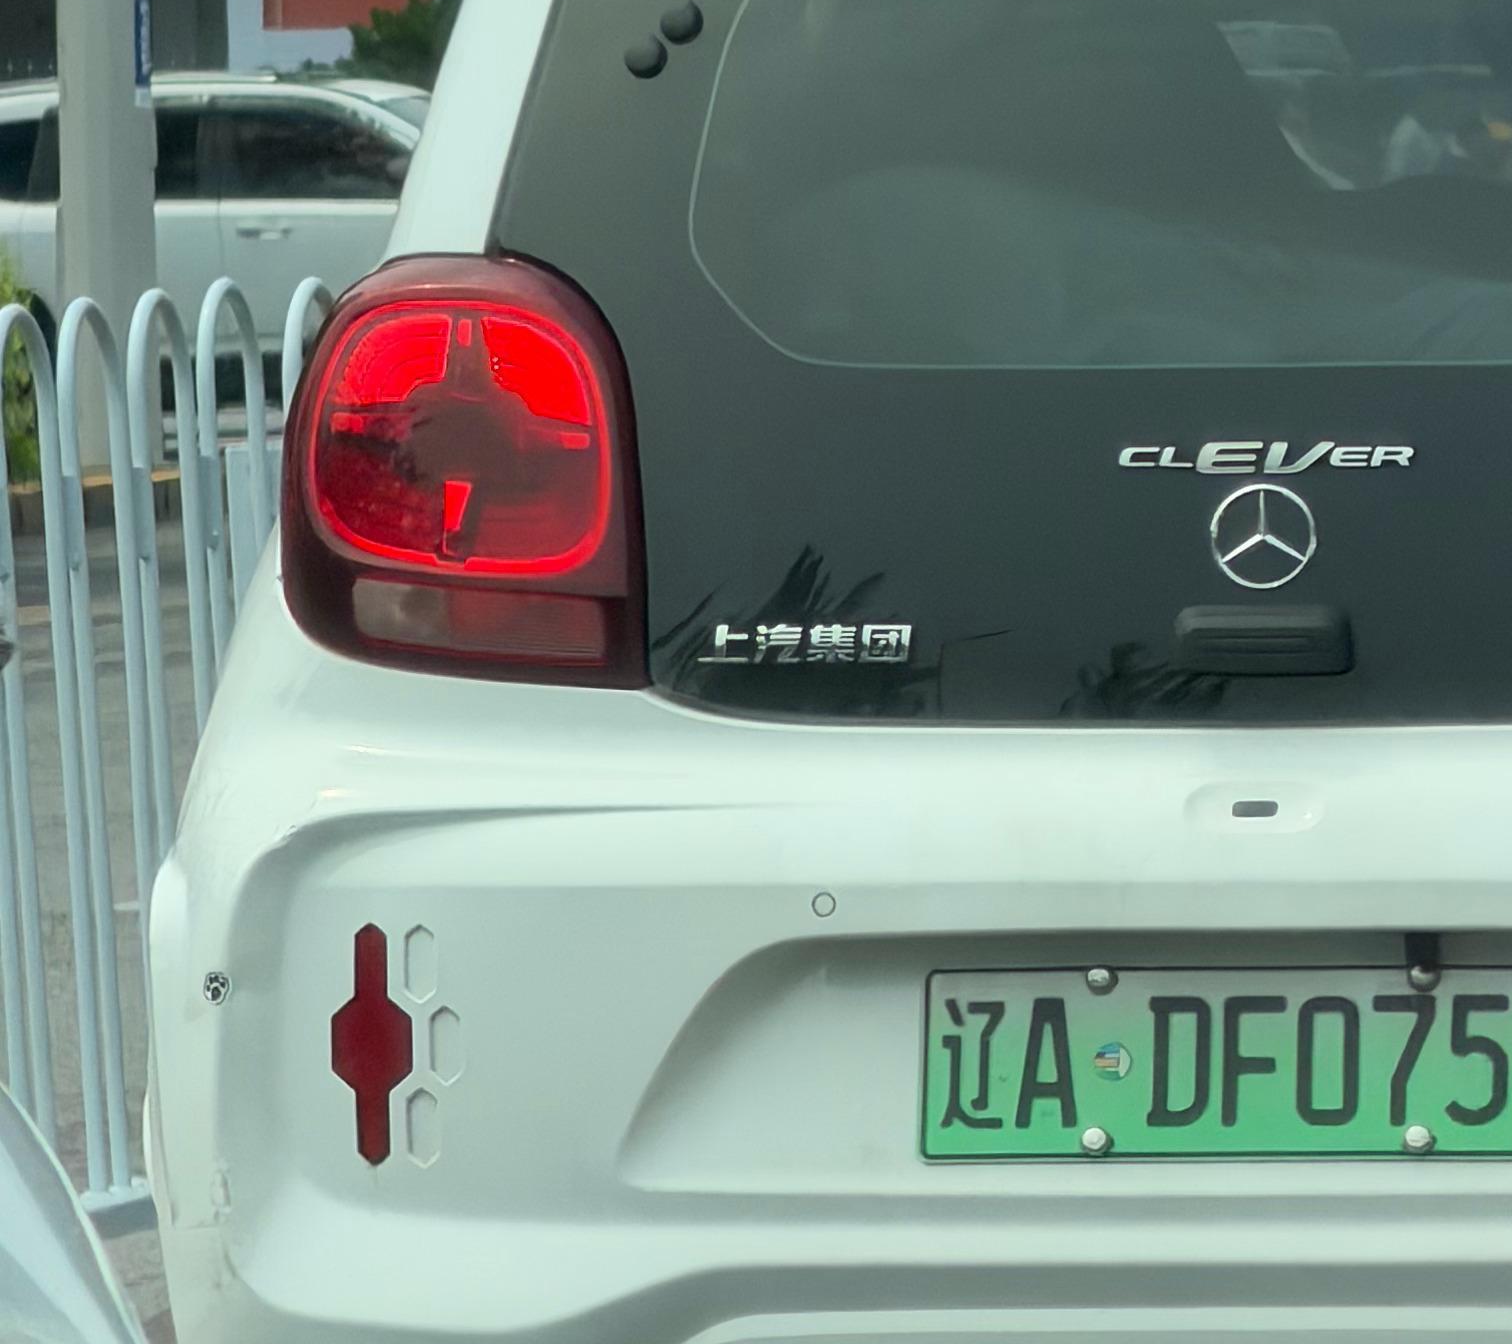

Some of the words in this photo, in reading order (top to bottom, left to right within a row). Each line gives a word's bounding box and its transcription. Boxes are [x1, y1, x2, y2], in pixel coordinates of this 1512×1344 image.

[1118, 441, 1415, 474] CLEVER
[697, 624, 912, 664] 上汽集团
